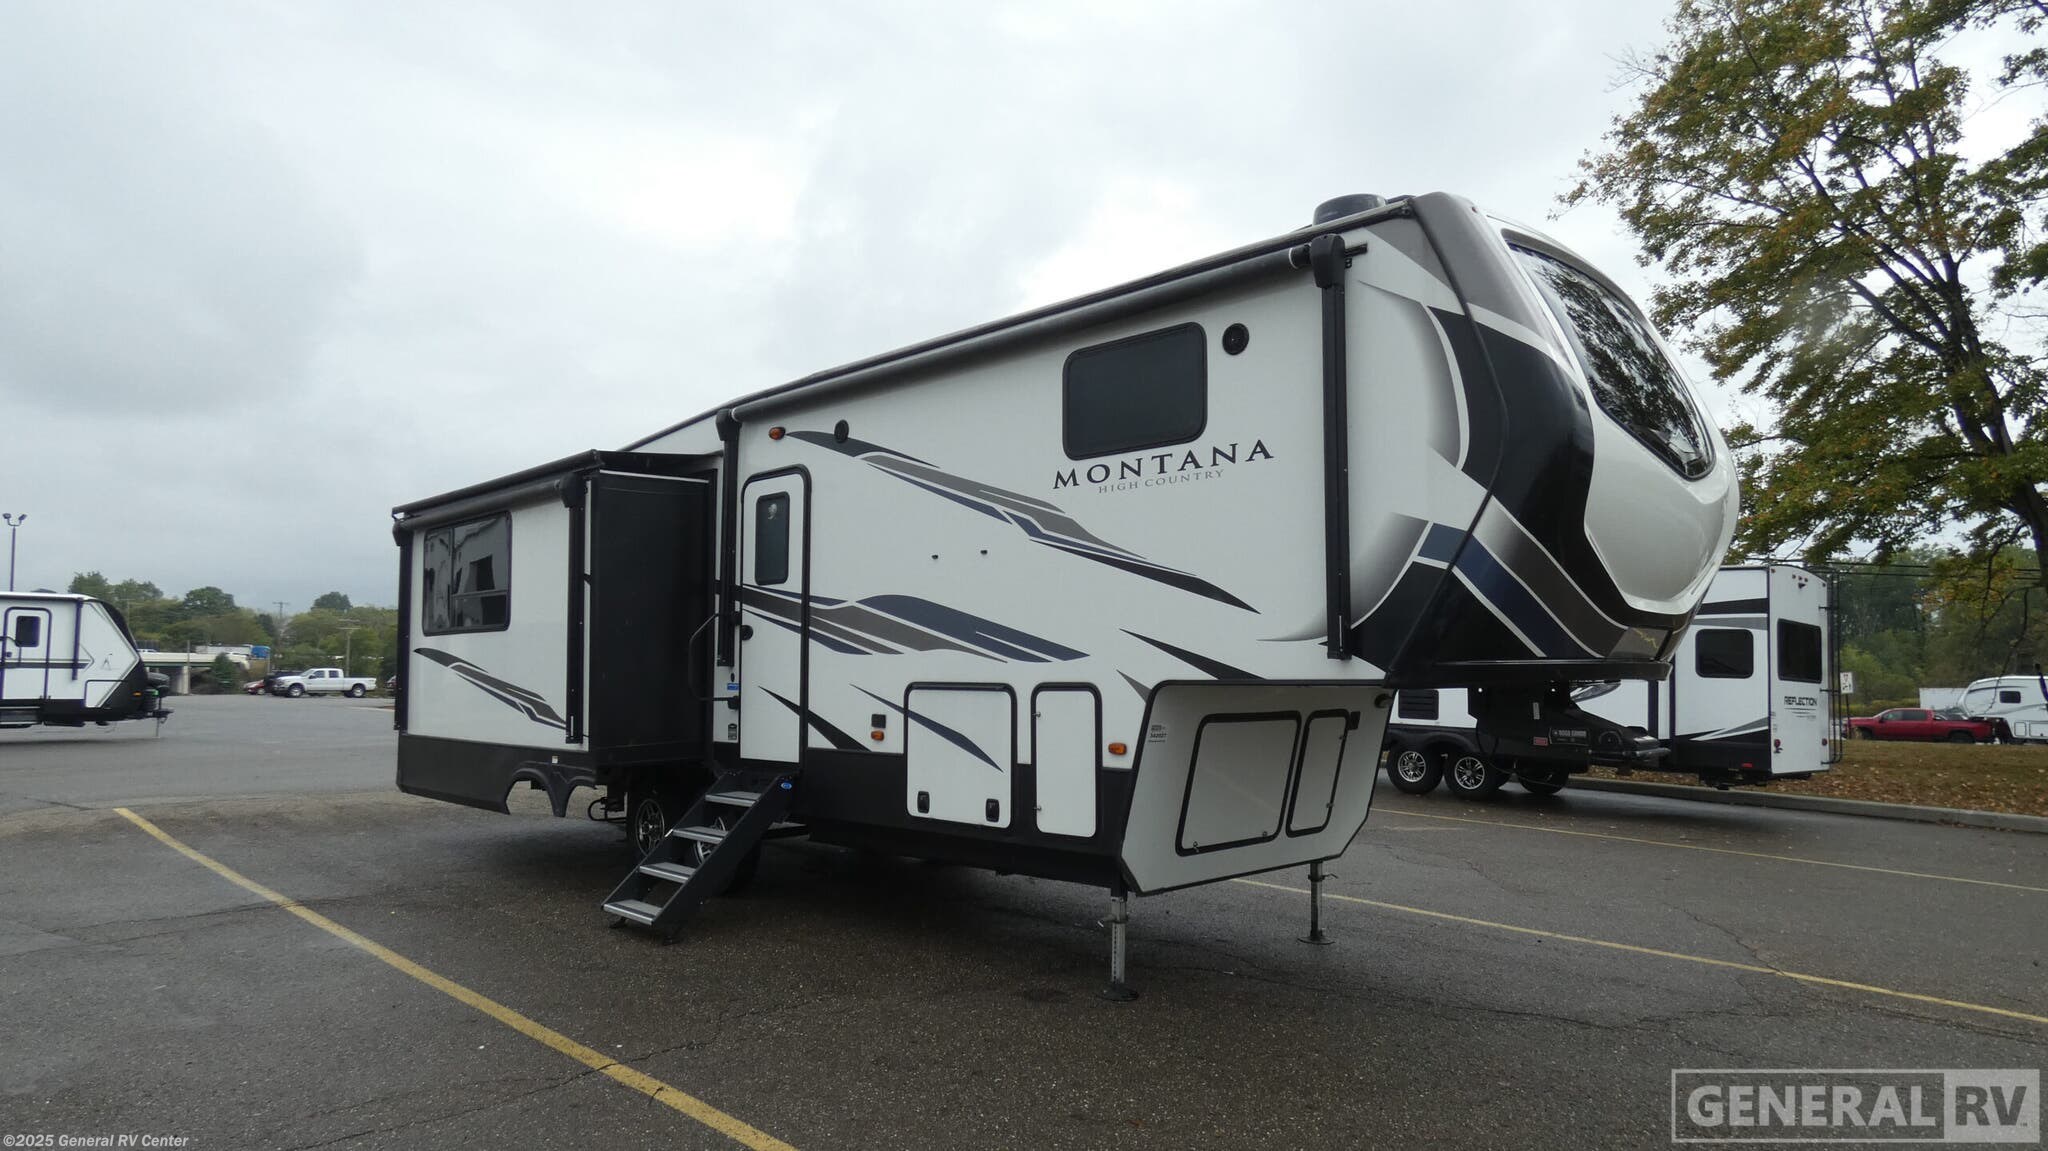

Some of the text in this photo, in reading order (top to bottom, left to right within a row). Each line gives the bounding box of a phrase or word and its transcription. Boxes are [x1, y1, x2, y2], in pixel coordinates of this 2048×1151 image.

[1052, 439, 1274, 490] MONTANA
[1098, 468, 1225, 494] HIGH COUNTRY
[1784, 696, 1817, 706] REFLECTION
